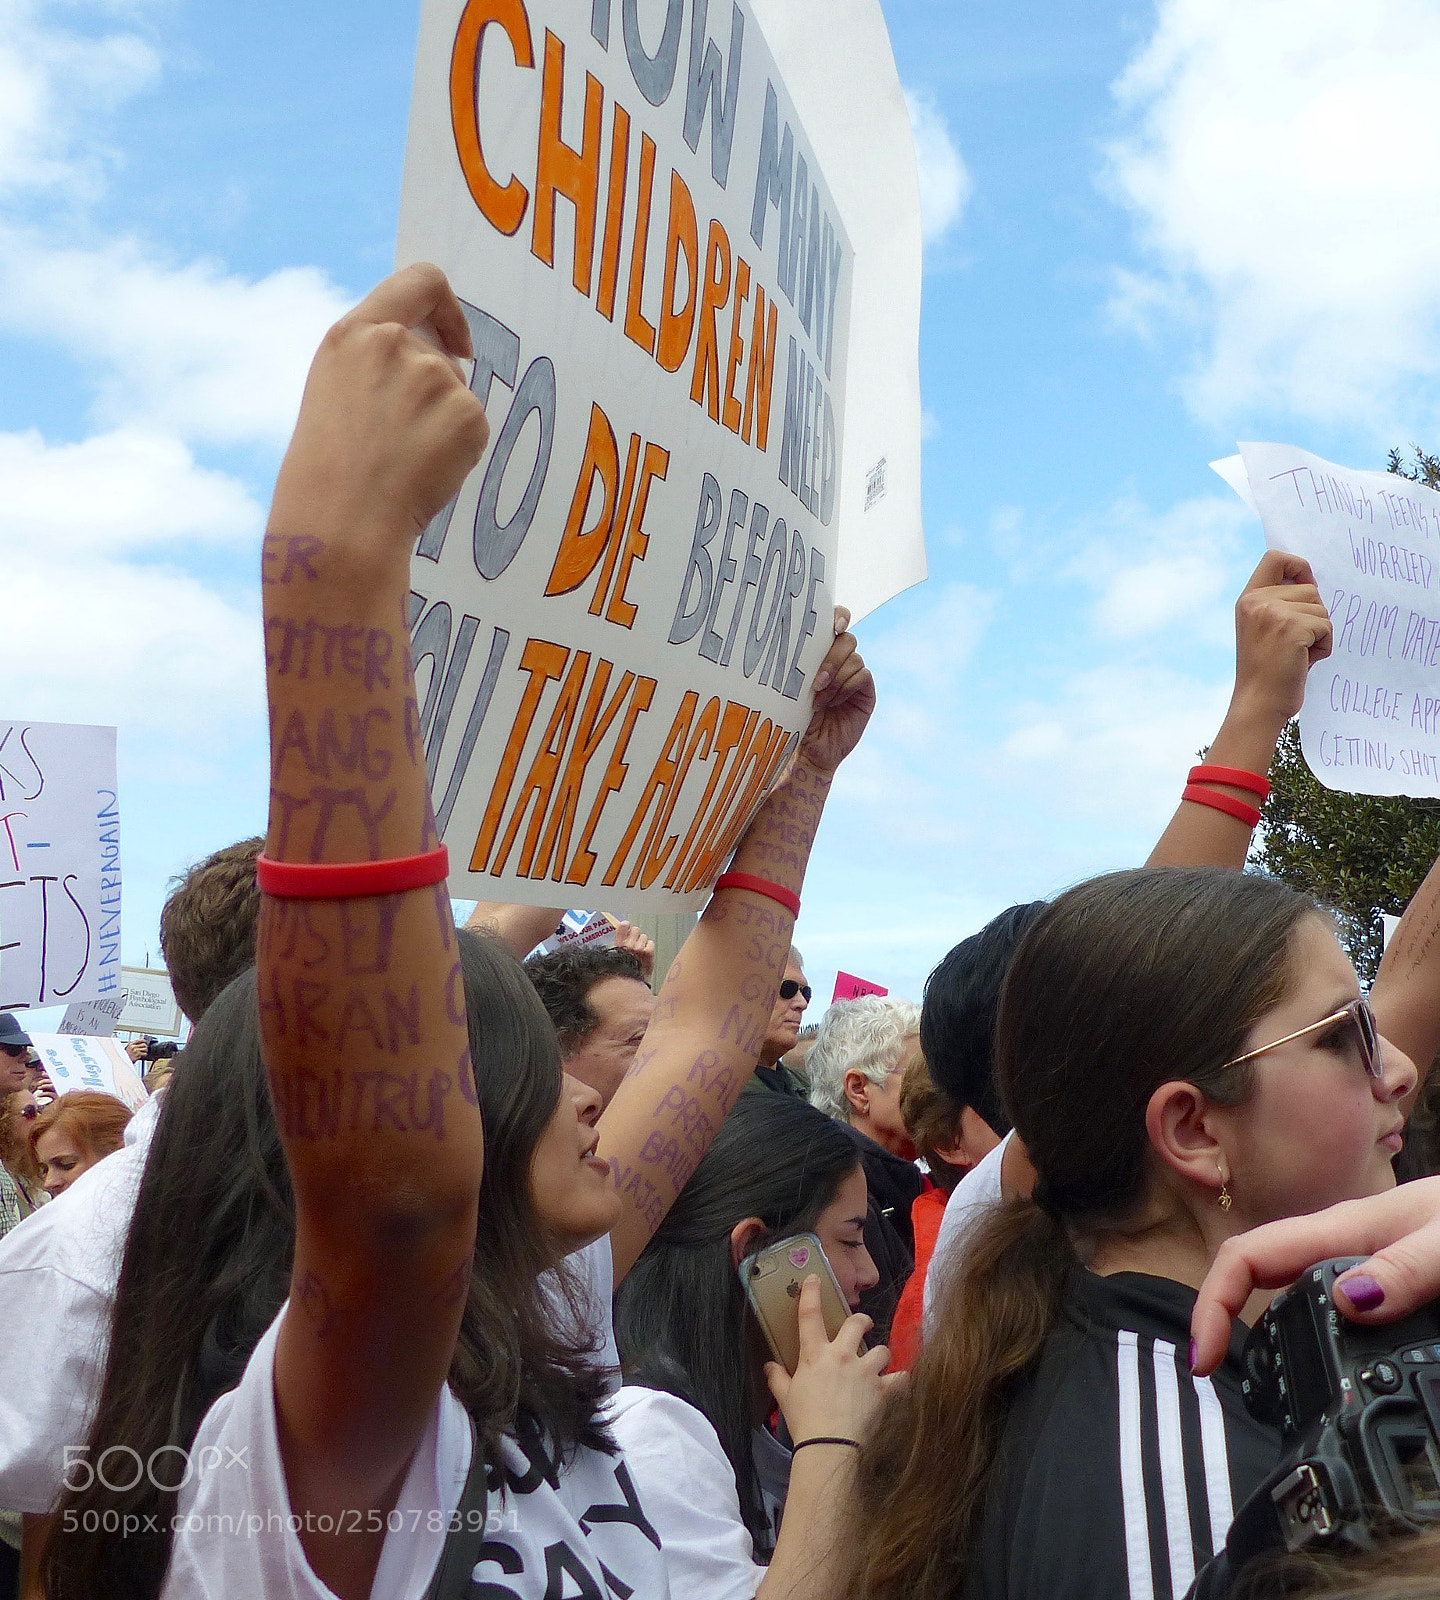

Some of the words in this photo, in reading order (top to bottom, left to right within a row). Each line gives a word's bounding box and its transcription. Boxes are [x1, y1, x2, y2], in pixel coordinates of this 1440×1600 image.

[584, 0, 744, 190] OW
[750, 78, 842, 381] MANY
[449, 0, 778, 453] CHILDREN
[778, 335, 836, 526] NEED
[1268, 466, 1373, 525] THINGS
[1377, 490, 1429, 539] TEENS
[544, 401, 670, 630] DIE
[668, 473, 826, 701] BEFORE
[1348, 527, 1432, 590] WORRIED
[1329, 589, 1399, 659] PROM
[1330, 674, 1403, 721] COLLEGE
[410, 590, 510, 844] OU
[468, 638, 658, 887] TAKE
[1319, 730, 1395, 772] GETTING
[1400, 749, 1440, 783] SHOT
[96, 789, 122, 993] #NEVERAGAIN
[557, 935, 569, 944] WE
[569, 932, 579, 941] DO
[581, 926, 616, 945] AMERICAN
[142, 989, 160, 998] Diego
